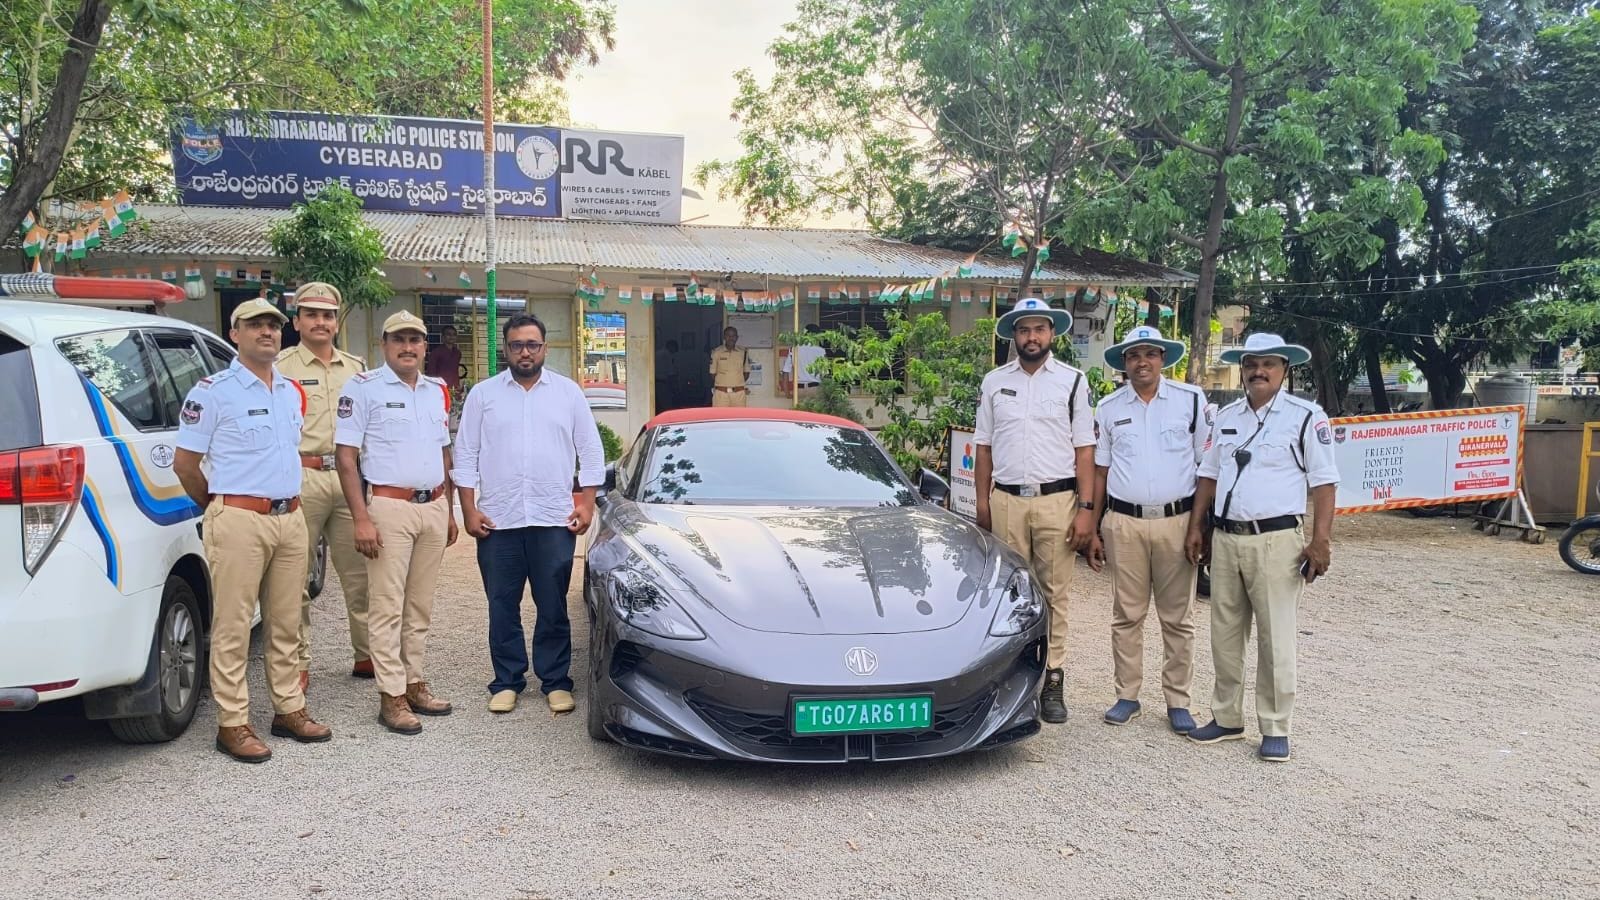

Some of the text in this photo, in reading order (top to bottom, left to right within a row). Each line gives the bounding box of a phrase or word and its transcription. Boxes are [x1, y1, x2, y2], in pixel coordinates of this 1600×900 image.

[225, 117, 347, 142] RADRANAGAR
[409, 126, 457, 149] POLICE
[459, 129, 515, 153] STAION
[319, 146, 443, 170] CYBERABAD
[561, 137, 634, 177] RR
[192, 169, 299, 200] రాజేంద్రనగర్
[405, 178, 448, 207] స్టేషన్
[561, 185, 586, 193] WIRES
[595, 186, 625, 194] CABLES
[632, 188, 671, 197] SWITCHES
[574, 197, 657, 207] SWITCHGEARS FANS
[571, 208, 661, 218] LIGHTING APPLIANCES
[1351, 424, 1428, 440] RAJENDRANAGAR
[1430, 421, 1465, 433] TRAFFIC
[1467, 418, 1497, 430] POLICE
[1364, 446, 1404, 457] FRIENDS
[1459, 440, 1507, 452] BIKANERVALA
[1364, 467, 1403, 479] FRIENDS
[1362, 477, 1404, 490] DRINK AND
[847, 648, 876, 674] MG
[809, 701, 929, 726] TG07AR6111
